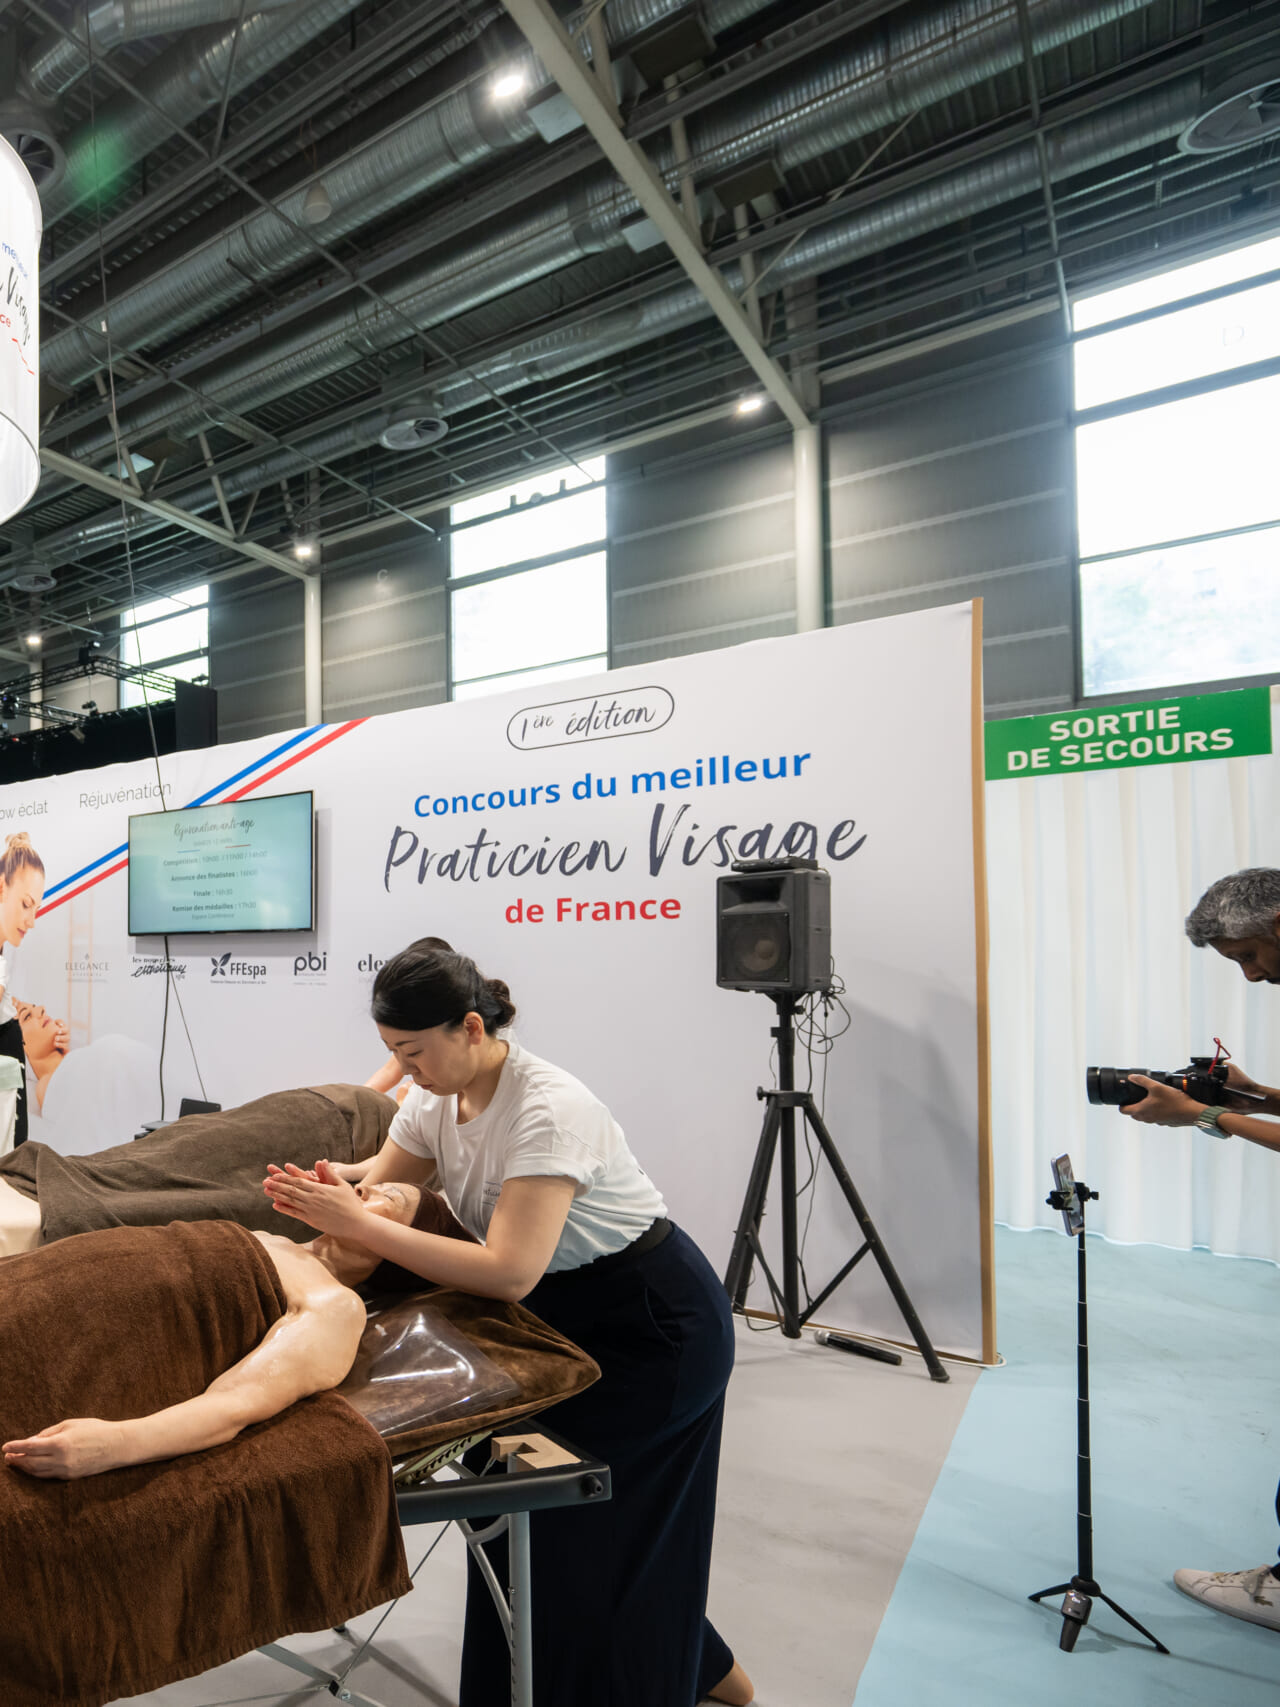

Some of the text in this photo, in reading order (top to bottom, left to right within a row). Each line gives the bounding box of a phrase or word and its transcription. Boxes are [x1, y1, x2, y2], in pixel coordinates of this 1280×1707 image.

[565, 700, 657, 737] édition
[1049, 706, 1181, 742] SORTIE
[1007, 728, 1234, 771] DE SECOURS
[79, 782, 172, 809] Réjuvénation
[414, 752, 811, 818] Concours du meilleur
[18, 800, 48, 818] éclat
[384, 803, 868, 894] Praticien Visage
[505, 897, 681, 924] de France
[65, 961, 109, 971] ELEGANCE
[230, 962, 267, 979] FFEspa
[294, 951, 327, 977] pbi
[358, 953, 389, 973] ele
